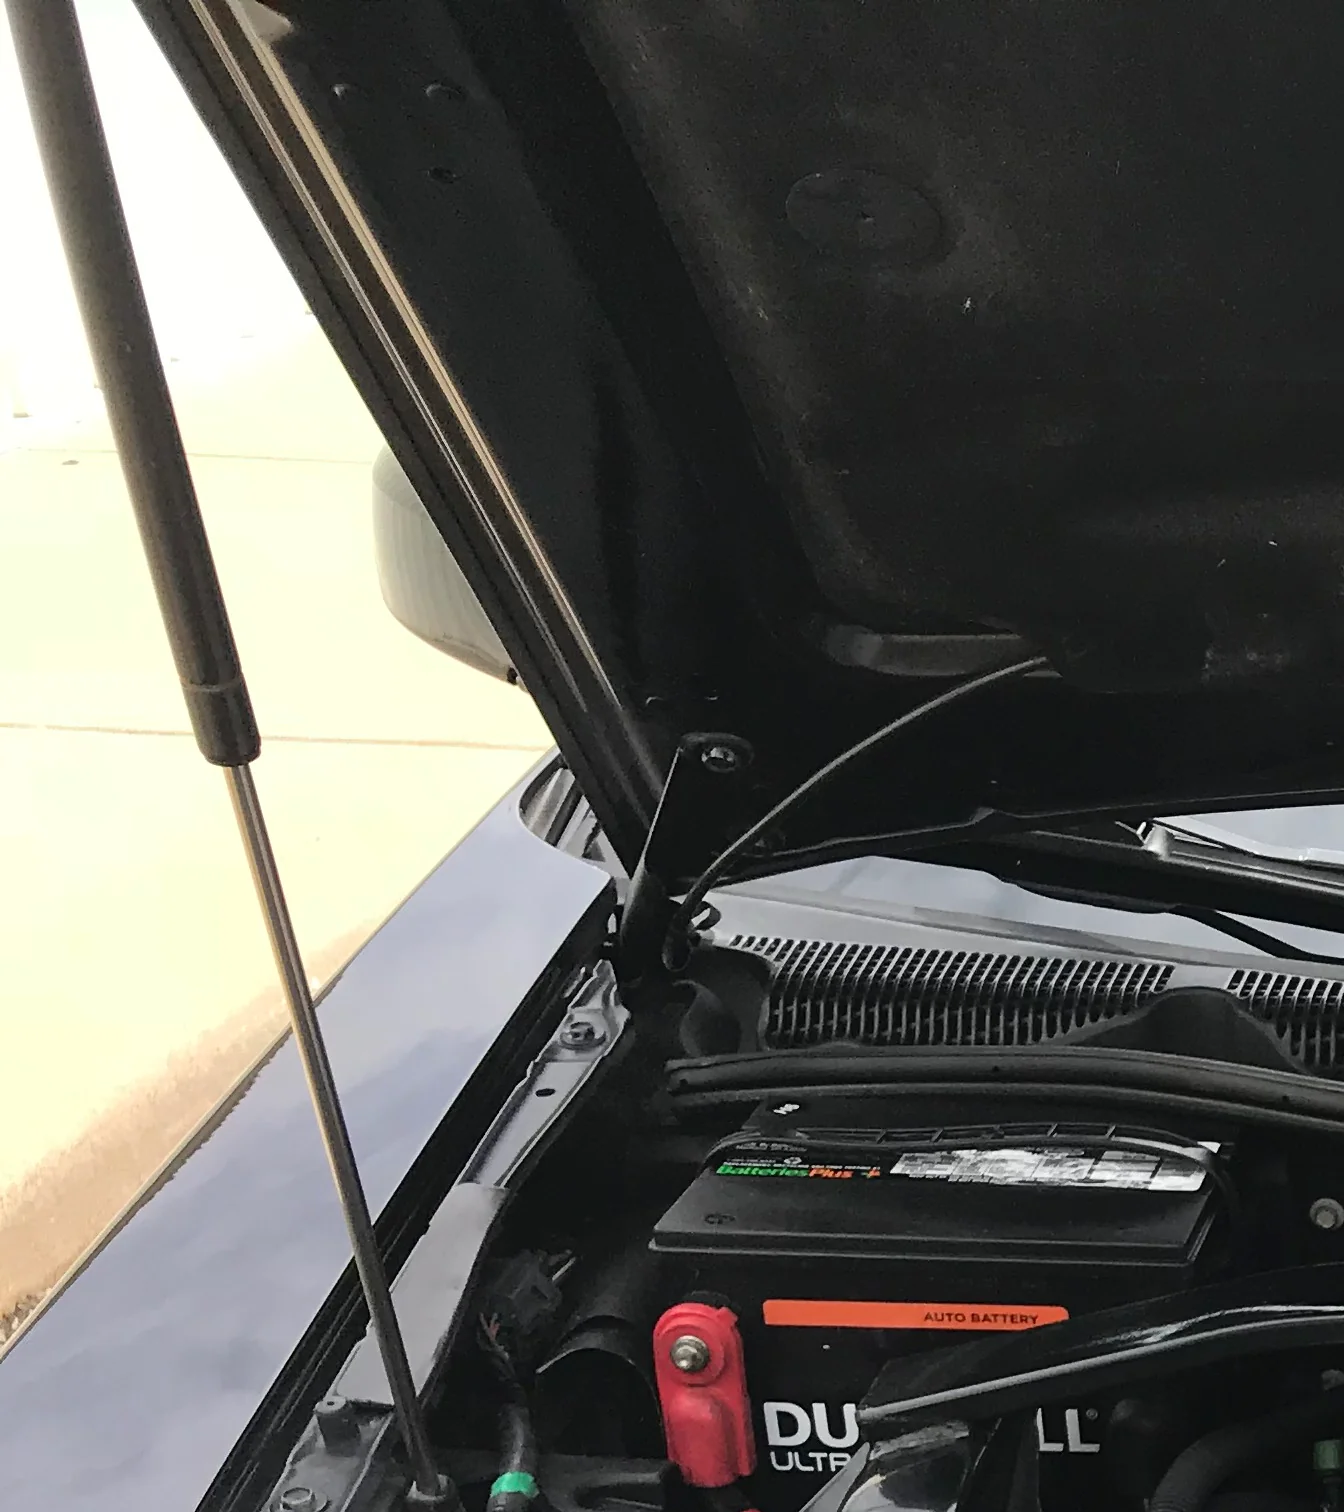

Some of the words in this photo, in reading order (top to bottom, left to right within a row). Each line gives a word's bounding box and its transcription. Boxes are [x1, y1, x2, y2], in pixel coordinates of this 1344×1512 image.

[923, 1311, 966, 1323] AUTO
[971, 1312, 1039, 1325] BATTERY
[763, 1402, 1100, 1453] DULL
[769, 1451, 852, 1472] ULTR
